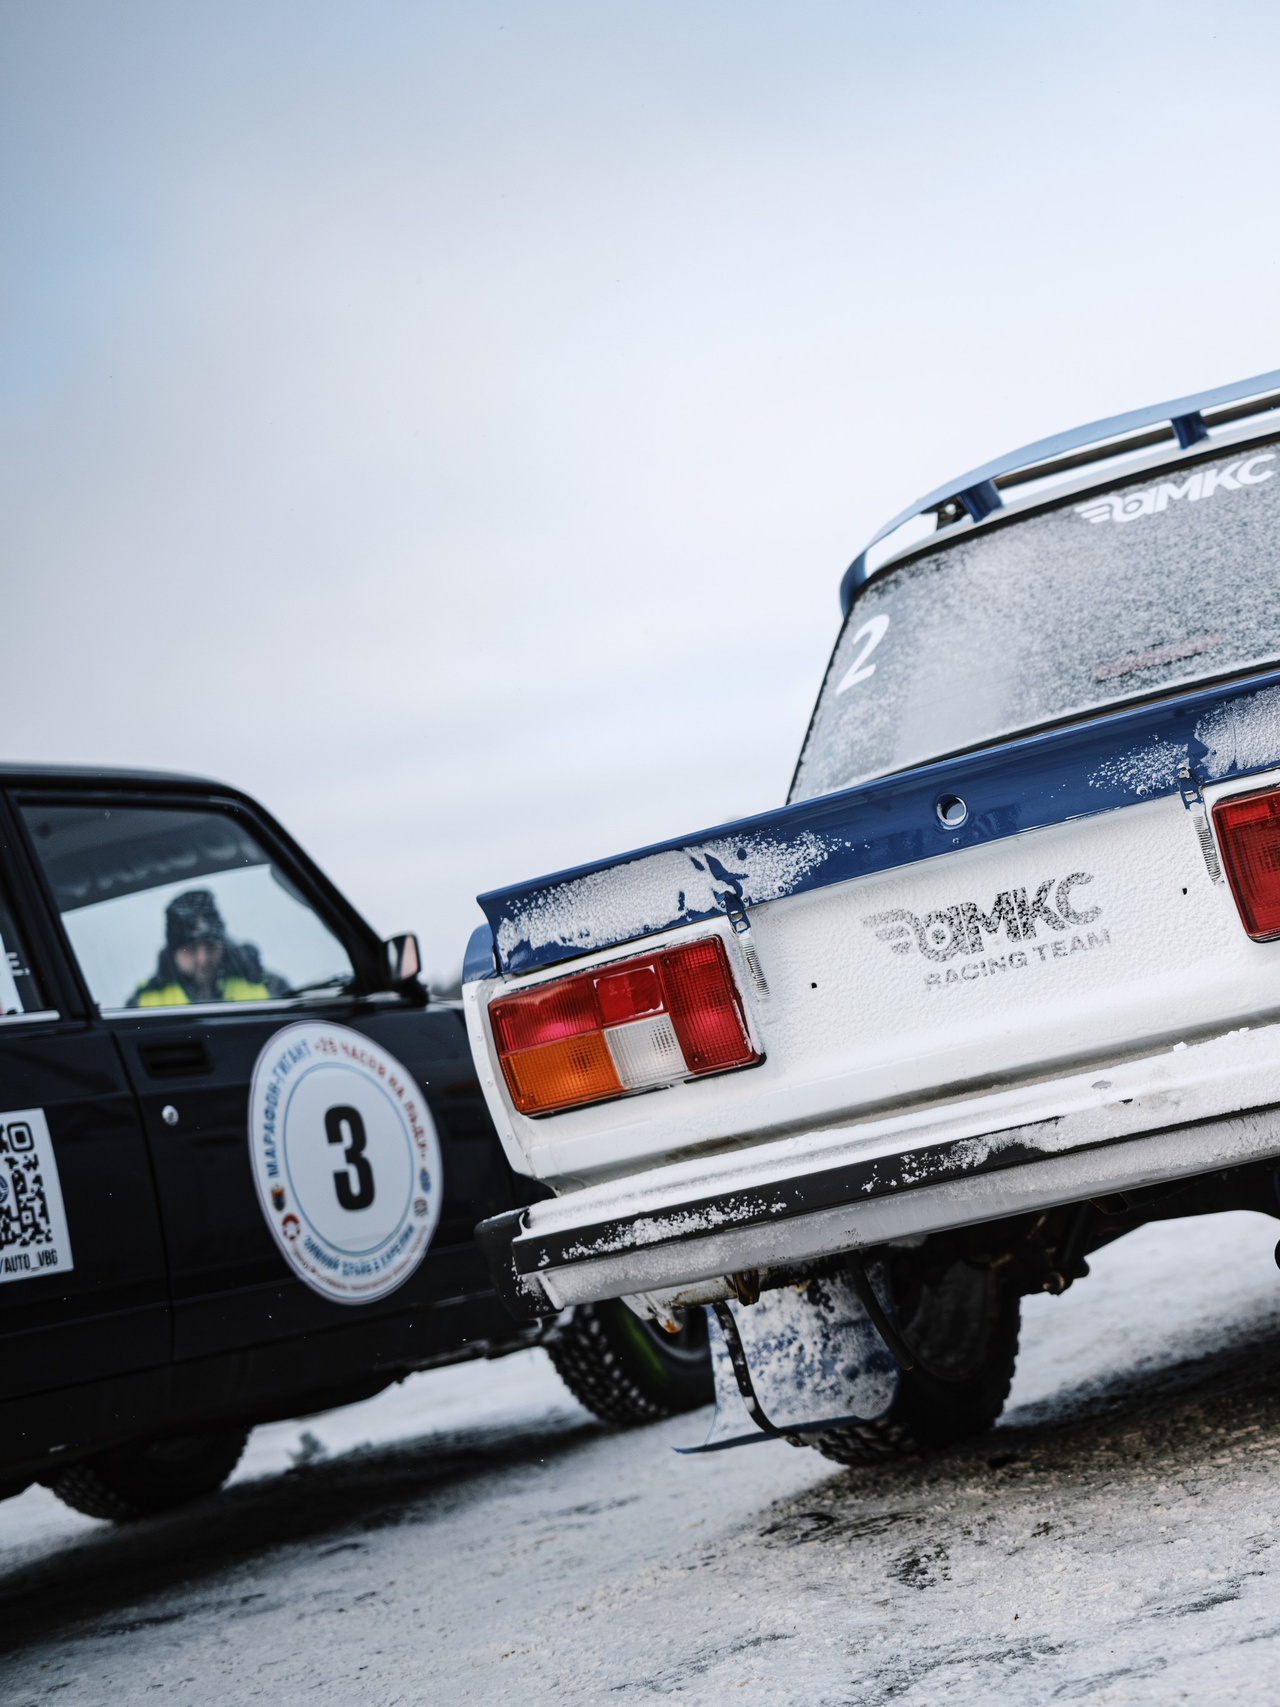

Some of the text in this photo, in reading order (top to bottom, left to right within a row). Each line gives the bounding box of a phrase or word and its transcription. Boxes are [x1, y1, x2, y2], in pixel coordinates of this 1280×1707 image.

[836, 614, 890, 695] 2
[923, 928, 1112, 991] RACING TEAM
[388, 1073, 405, 1099] НА
[324, 1104, 376, 1212] 3
